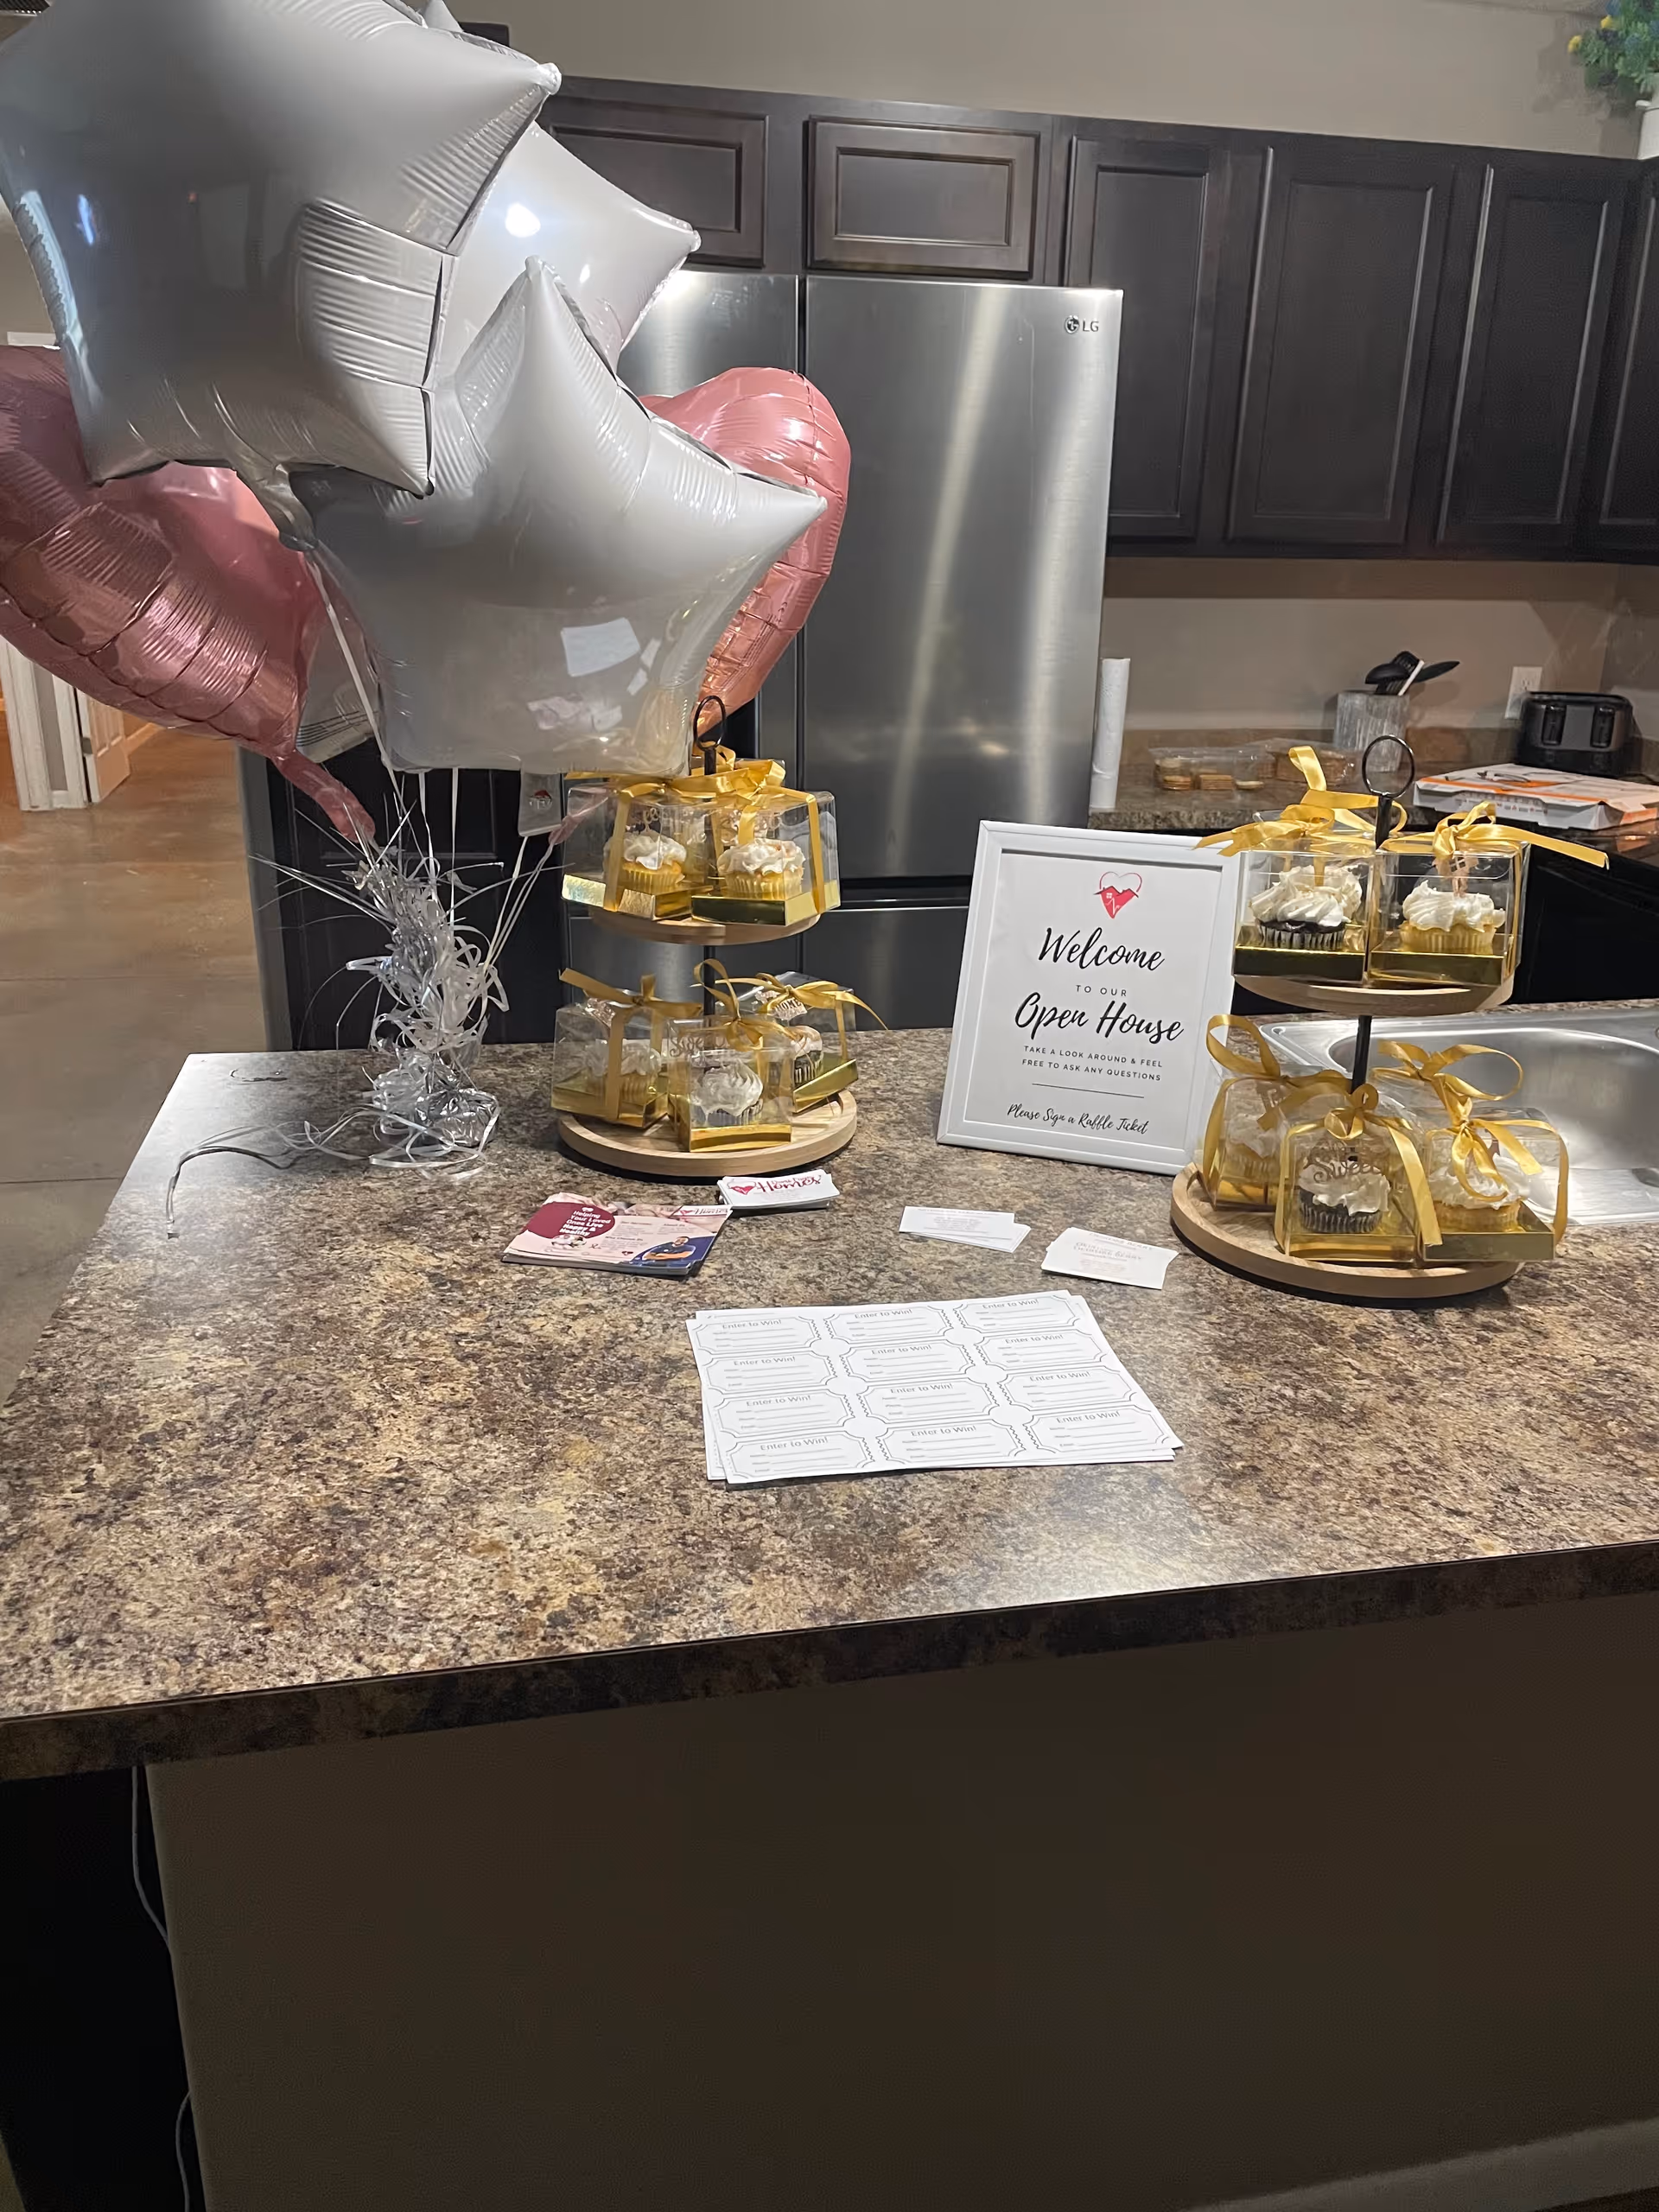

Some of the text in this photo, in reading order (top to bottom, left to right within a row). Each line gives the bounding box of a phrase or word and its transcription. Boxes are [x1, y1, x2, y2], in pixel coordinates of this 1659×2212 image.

[1083, 321, 1099, 332] LG
[1038, 927, 1165, 971] Welcome
[1076, 985, 1128, 996] TO OUR
[1014, 991, 1184, 1044] Open House
[1024, 1046, 1046, 1054] TAKE
[1088, 1052, 1127, 1064] AROUND
[1107, 1069, 1161, 1081] QUESTIONS
[1007, 1103, 1040, 1120] Please
[1043, 1108, 1065, 1127] Sign
[1078, 1113, 1114, 1129] Raffle
[1116, 1118, 1149, 1135] Ticket
[1056, 1415, 1082, 1424] Enter
[760, 1442, 787, 1451] Enter
[803, 1436, 829, 1445] Win!
